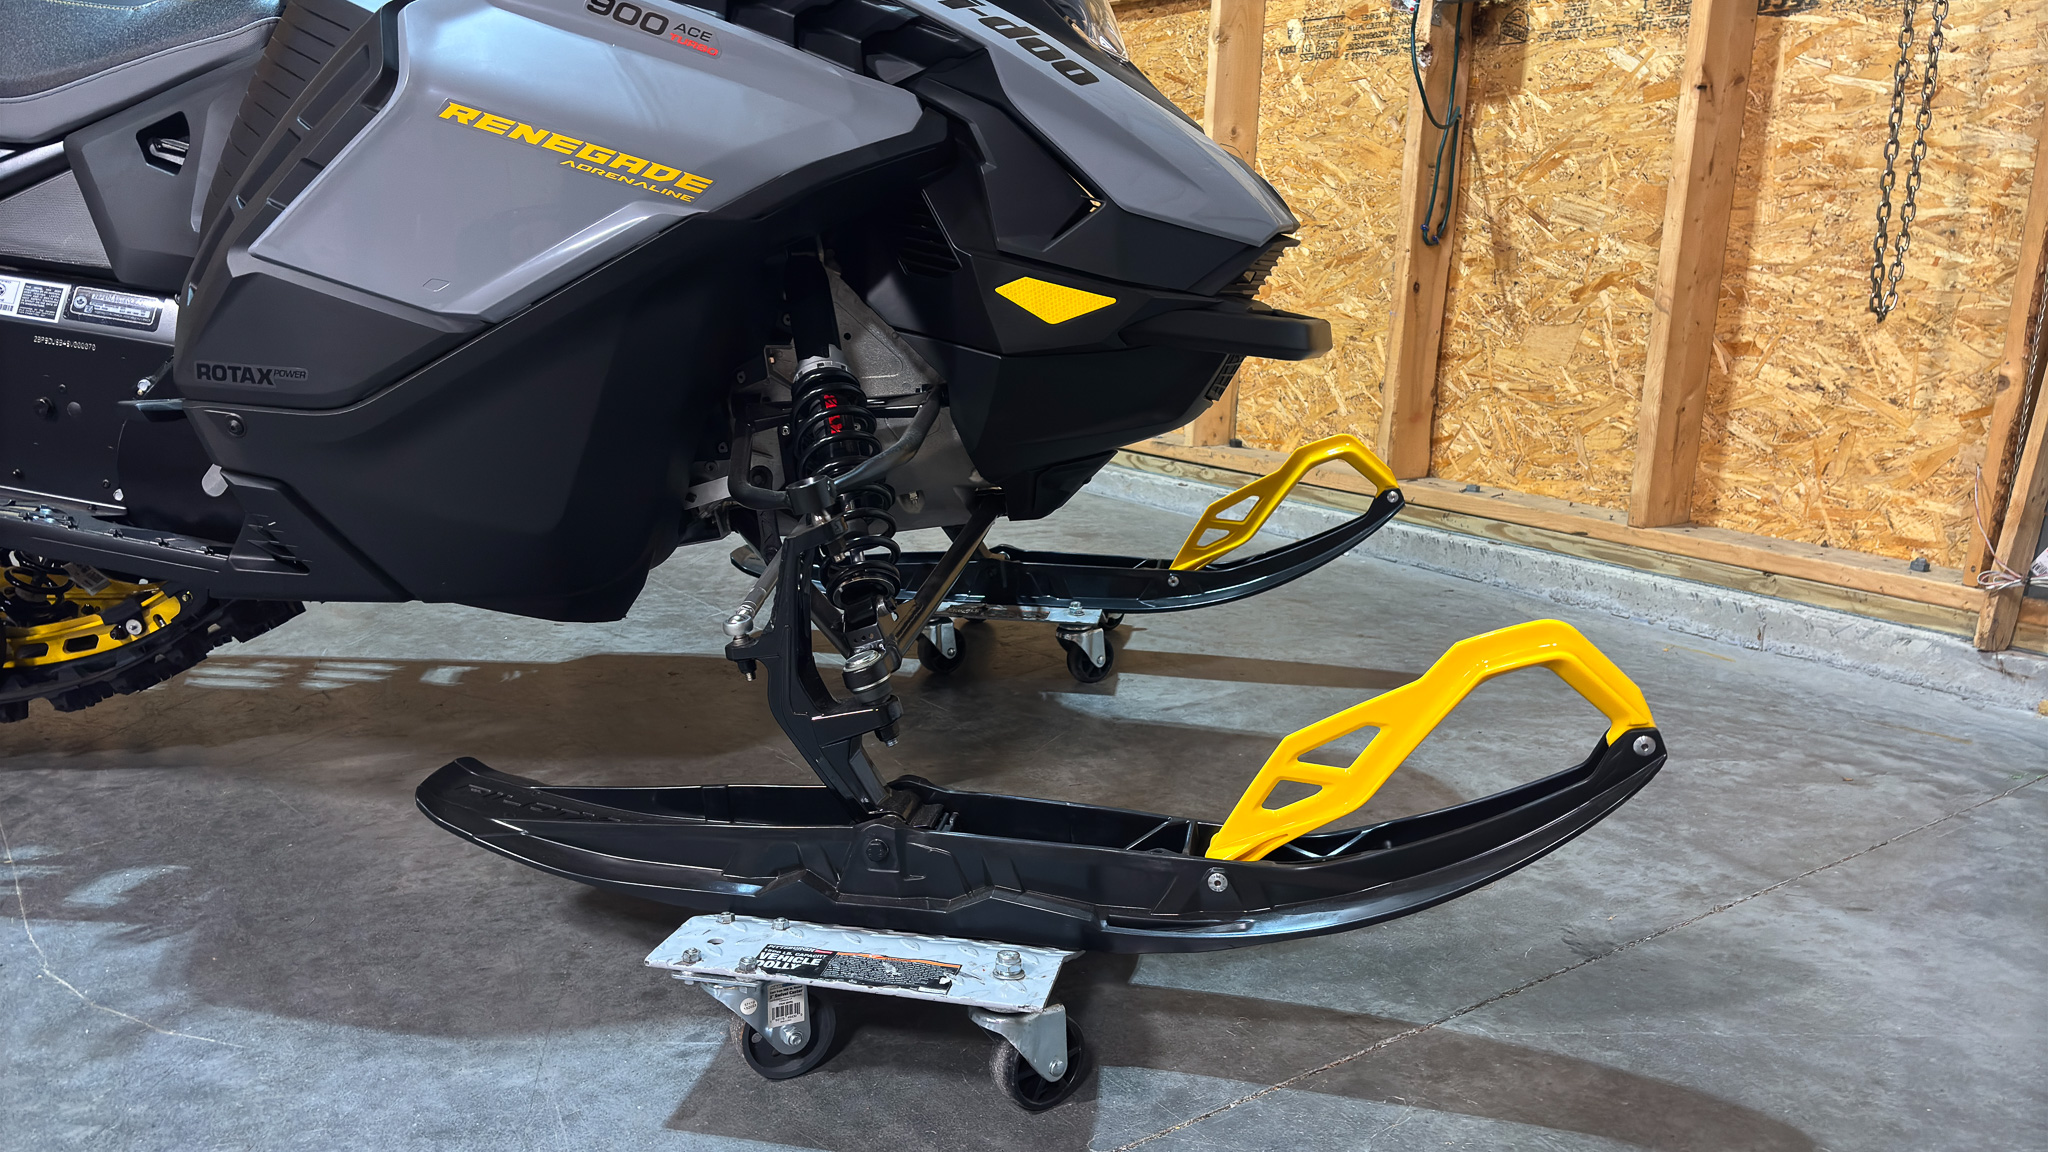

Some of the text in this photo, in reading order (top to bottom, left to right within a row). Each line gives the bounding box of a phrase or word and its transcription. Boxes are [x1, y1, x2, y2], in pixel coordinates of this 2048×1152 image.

[587, 0, 713, 42] 900 ACE
[670, 33, 719, 56] TURBO
[438, 102, 714, 194] RENEGADE
[560, 160, 695, 203] ADRENALINE
[196, 363, 307, 386] ROTAX POWER
[756, 959, 802, 970] DOLLY
[759, 951, 822, 966] VEHICLE
